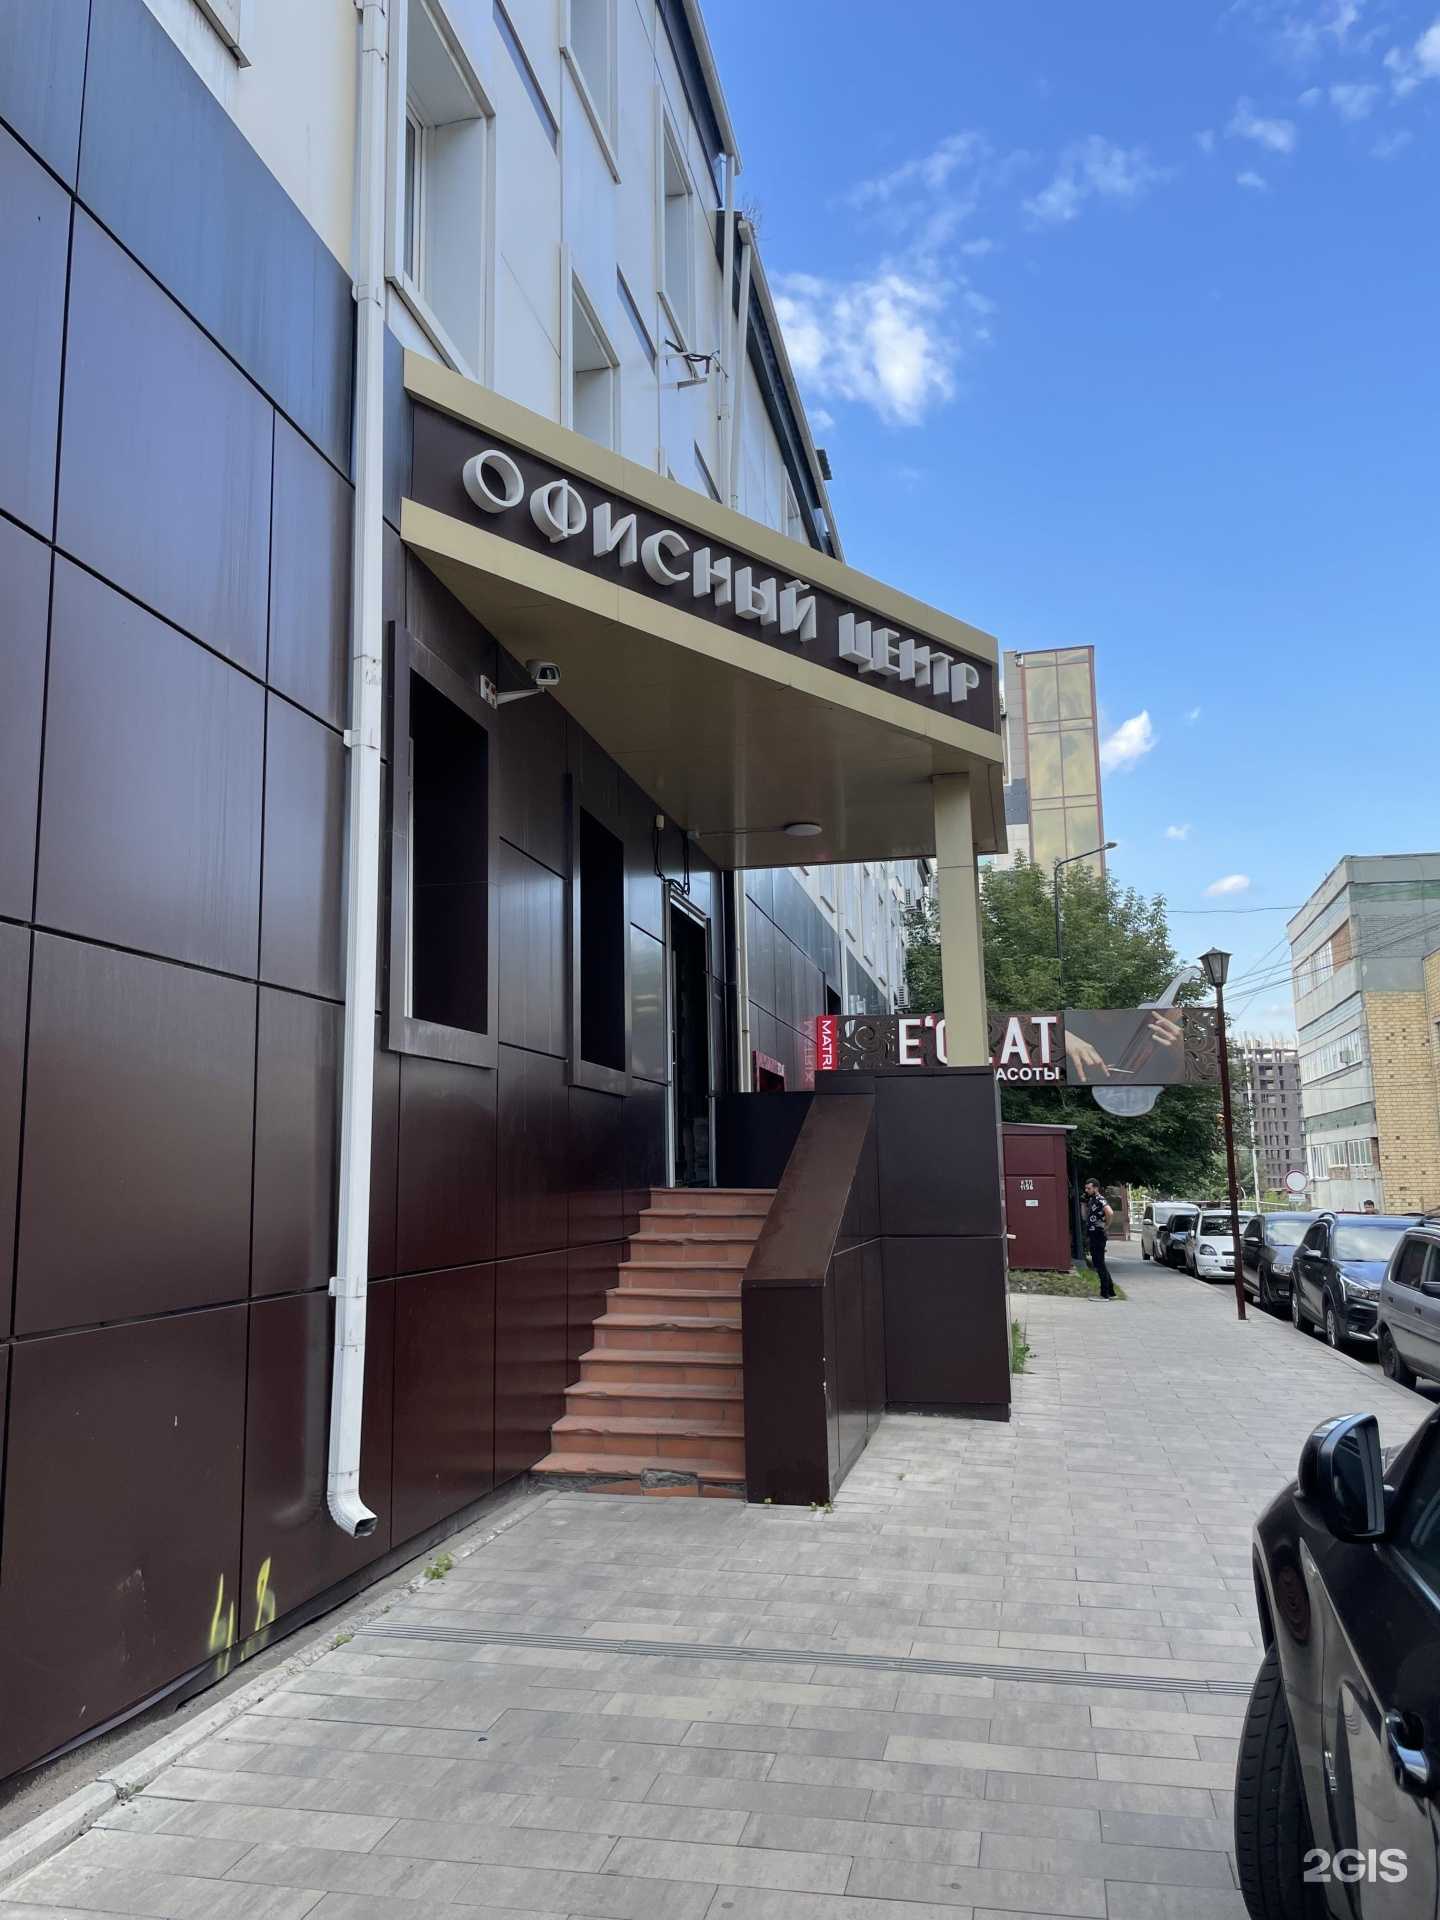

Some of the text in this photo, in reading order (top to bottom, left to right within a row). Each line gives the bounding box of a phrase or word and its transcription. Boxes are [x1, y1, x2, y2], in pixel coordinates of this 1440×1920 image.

[463, 450, 979, 703] ОФИСНЫЙ ЦЕНТР
[822, 1020, 832, 1070] MATRI
[996, 1067, 1060, 1081] АСОТЫ
